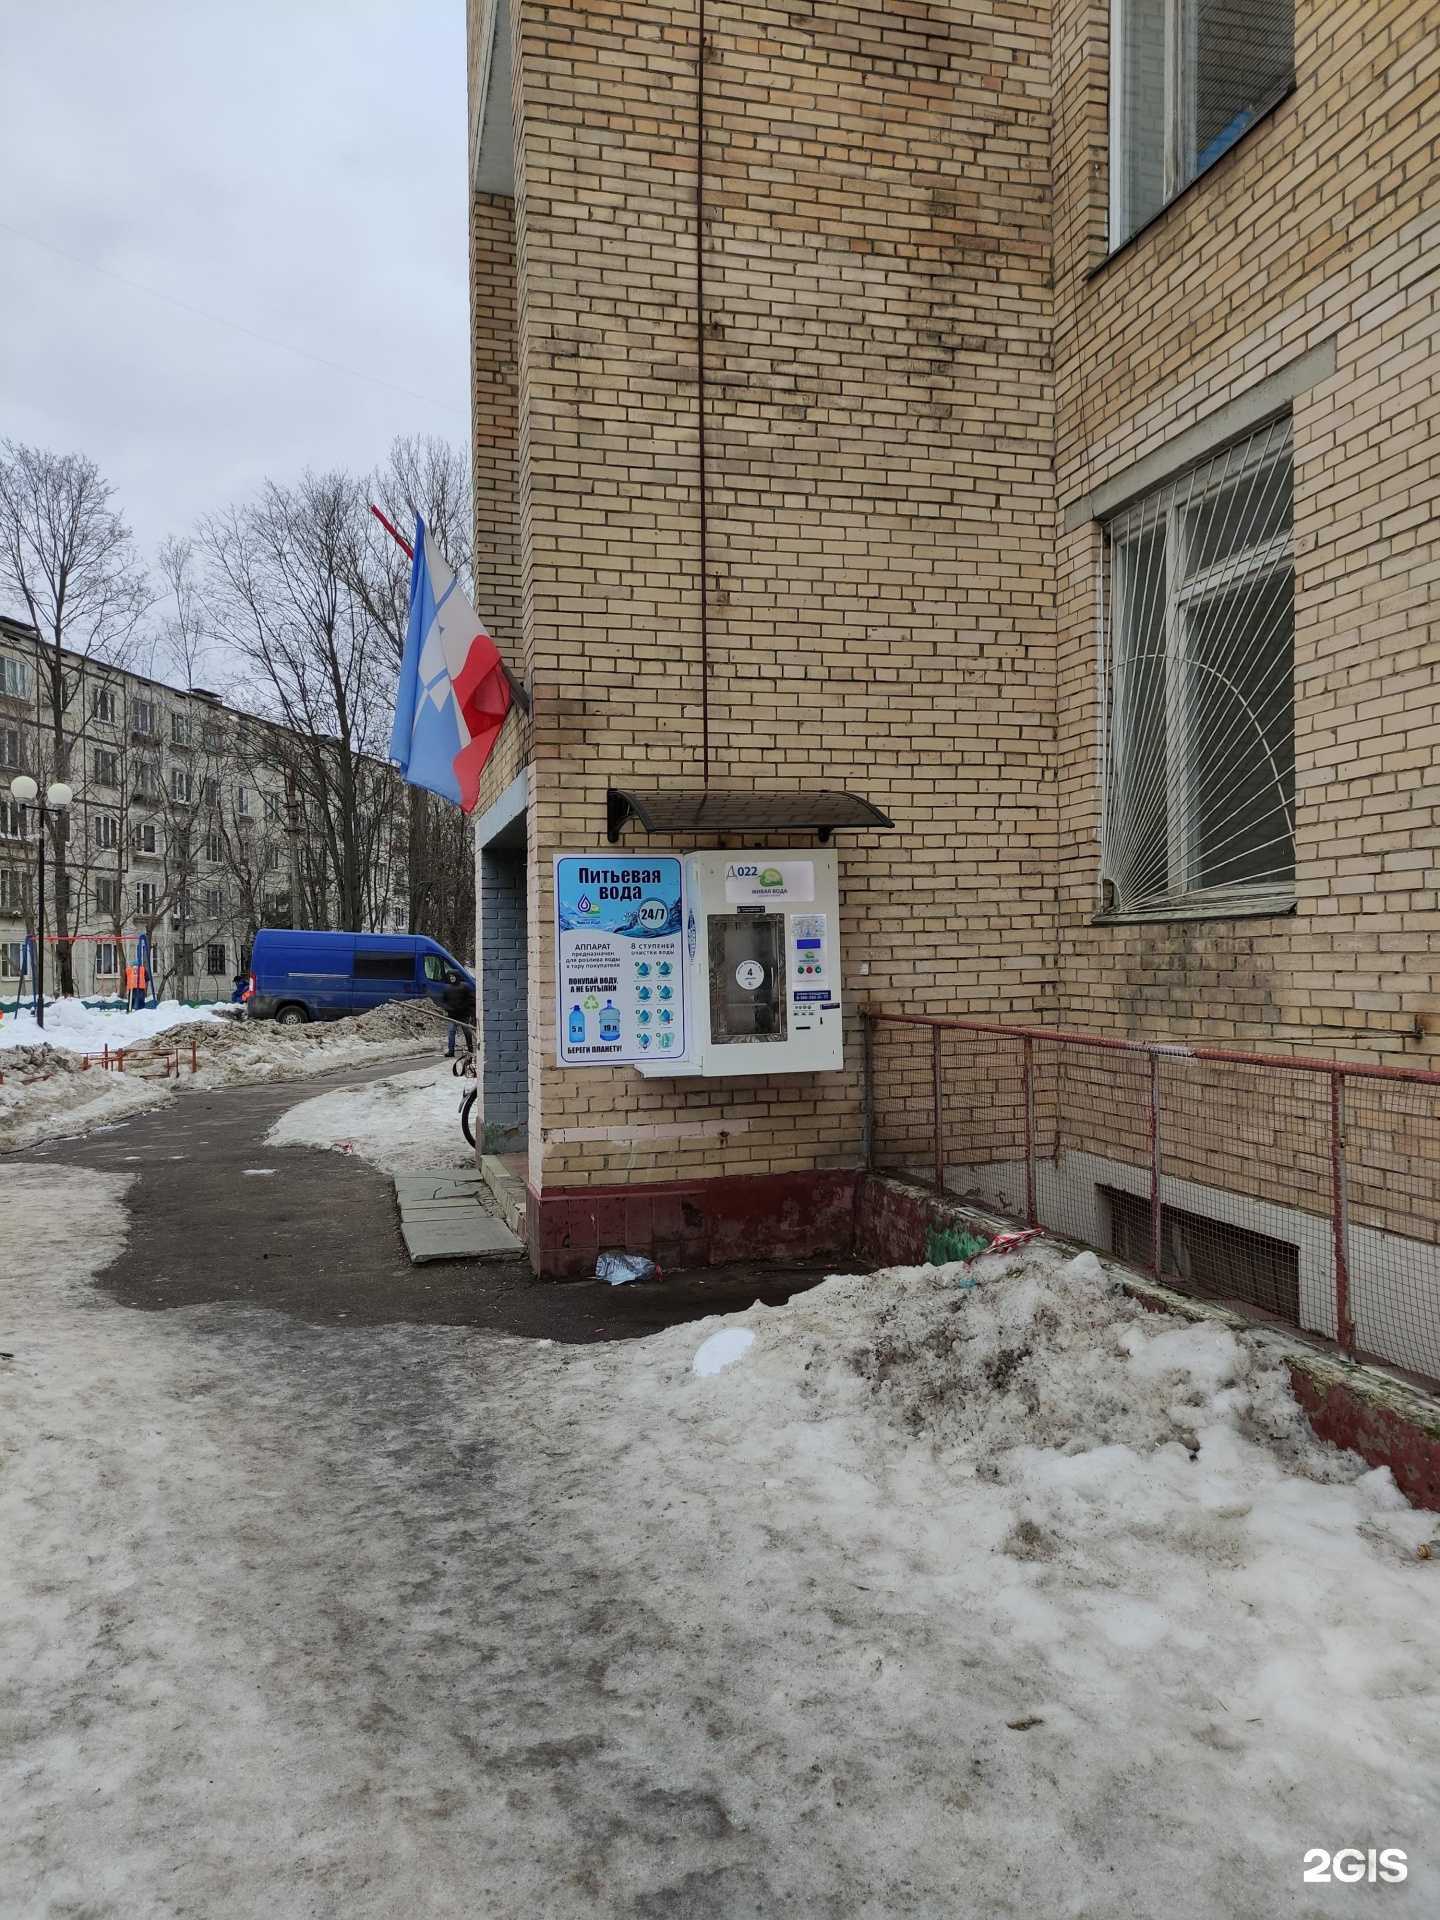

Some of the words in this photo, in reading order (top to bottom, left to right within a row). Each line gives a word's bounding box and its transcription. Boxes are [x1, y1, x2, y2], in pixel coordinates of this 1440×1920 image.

[578, 867, 661, 884] Питьевая
[599, 885, 642, 901] вода
[641, 908, 665, 920] 24/7
[575, 943, 611, 951] АППАРАТ
[569, 976, 599, 985] ПОКУПАЙ
[576, 985, 584, 993] НЕ
[567, 1046, 590, 1054] БЕРЕГИ
